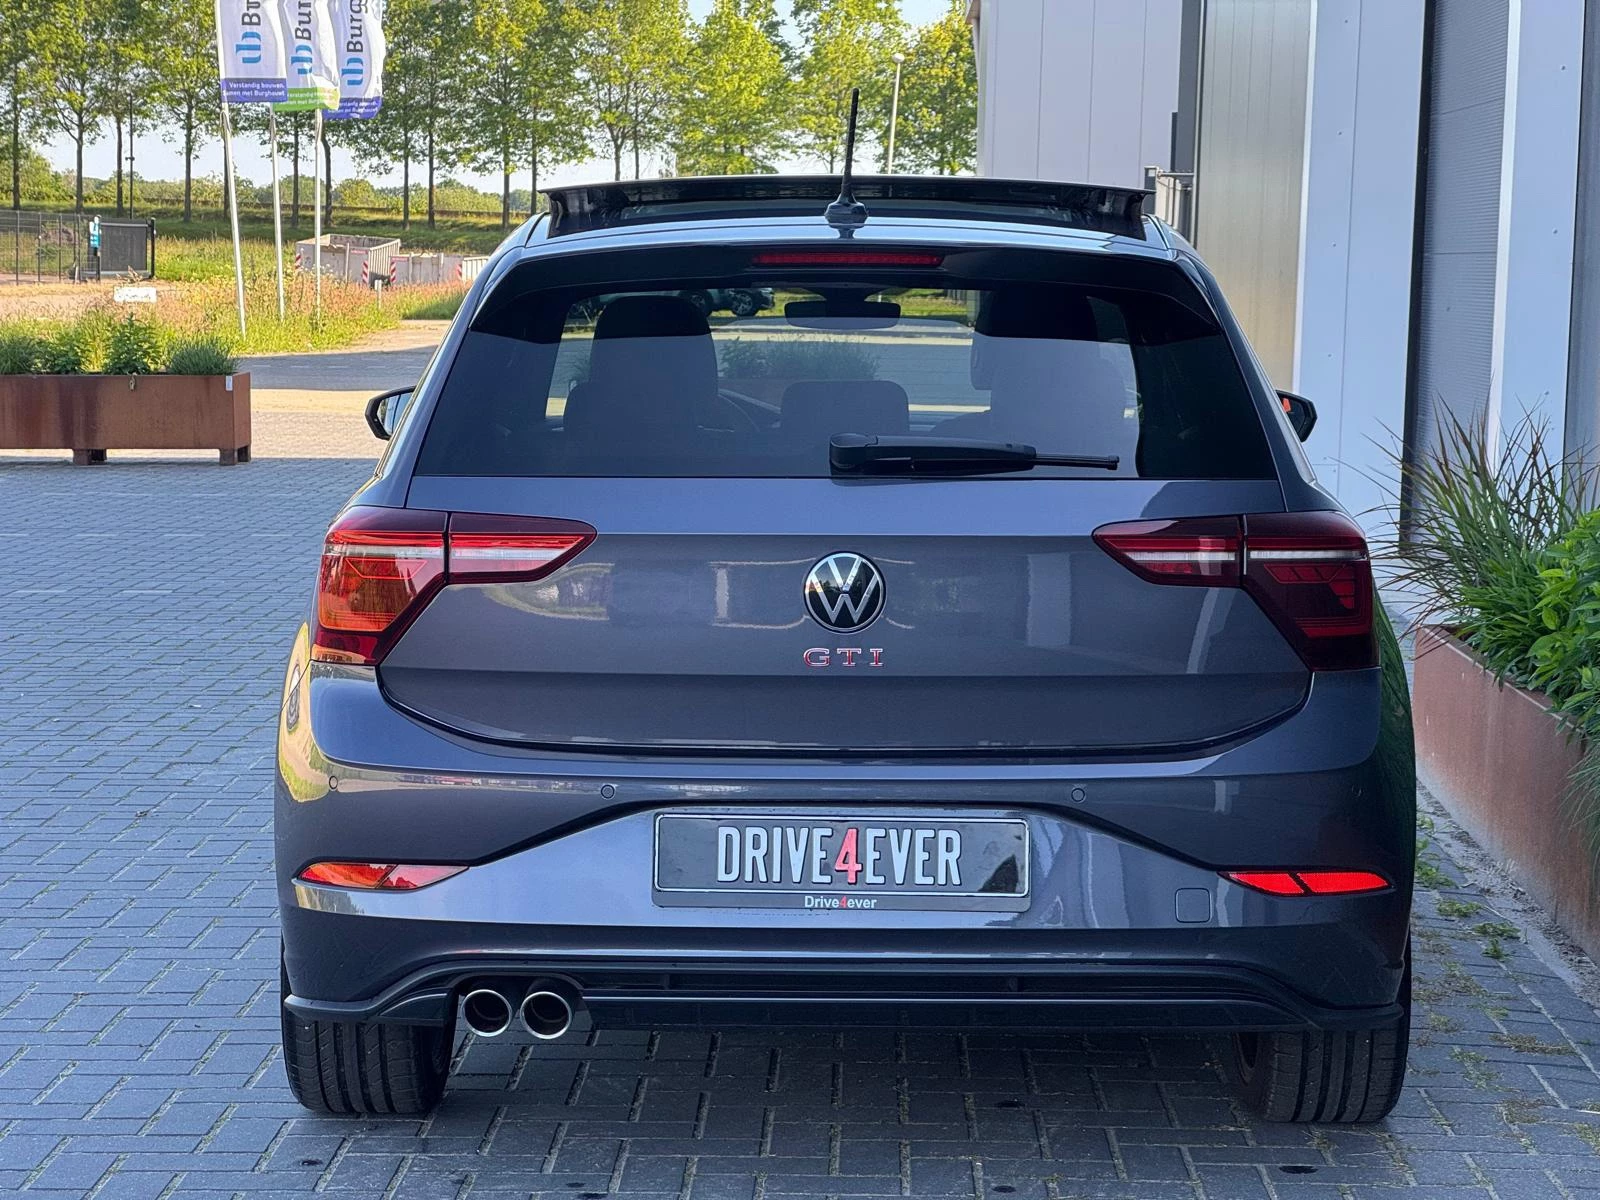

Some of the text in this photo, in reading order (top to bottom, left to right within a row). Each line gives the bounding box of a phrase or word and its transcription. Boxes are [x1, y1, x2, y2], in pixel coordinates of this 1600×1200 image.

[228, 81, 260, 89] Verstandig
[803, 647, 884, 668] GTI
[717, 826, 962, 887] DRIVE4EVER
[804, 895, 877, 909] Drive4ever
